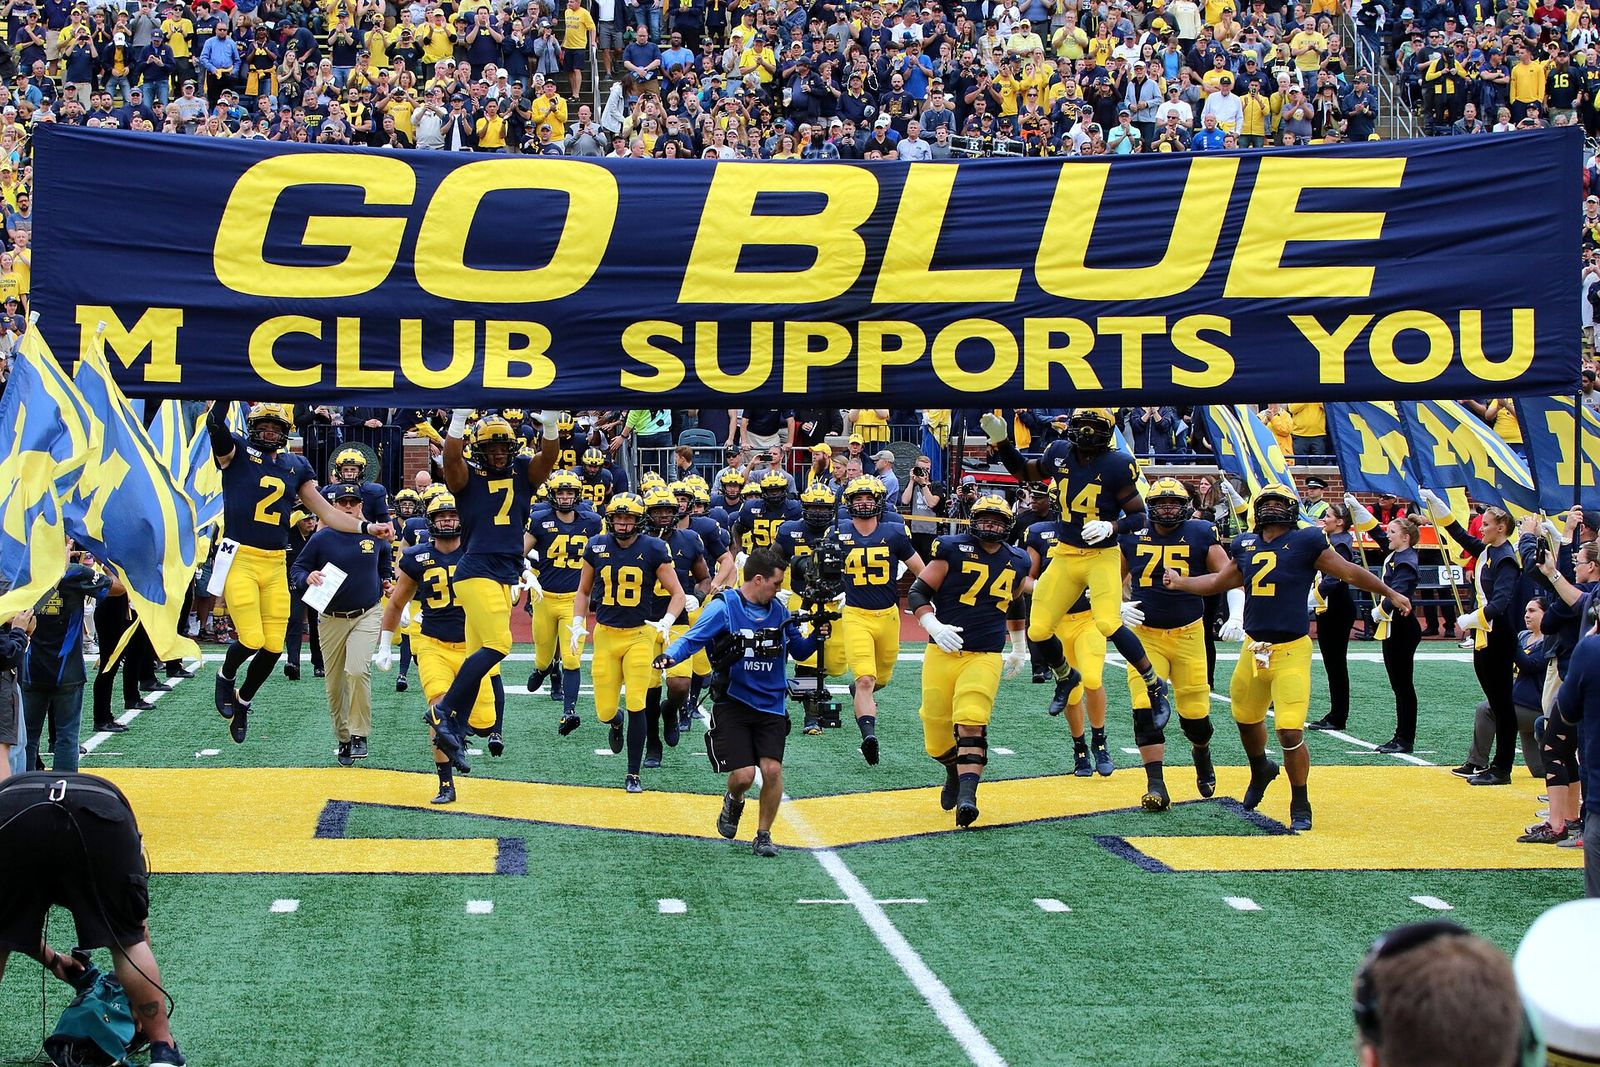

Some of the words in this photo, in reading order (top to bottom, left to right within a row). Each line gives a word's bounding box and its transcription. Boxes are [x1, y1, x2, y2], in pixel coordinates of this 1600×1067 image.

[1474, 4, 1483, 22] 1
[1554, 74, 1569, 88] 16
[970, 142, 978, 150] R
[998, 144, 1006, 152] R
[213, 153, 619, 304] GO
[678, 157, 1407, 305] BLUE
[73, 304, 184, 383] M
[248, 314, 556, 389] CLUB
[620, 314, 1236, 394] SUPPORTS
[1289, 308, 1536, 384] YOU
[254, 476, 286, 526] 2
[488, 478, 515, 526] 7
[1058, 478, 1102, 523] 14
[220, 542, 235, 554] M
[547, 534, 589, 570] 43
[844, 546, 890, 586] 45
[1136, 545, 1190, 588] 75
[600, 564, 643, 608] 18
[959, 560, 1017, 614] 74
[1251, 552, 1277, 596] 2
[743, 660, 774, 672] MSTV
